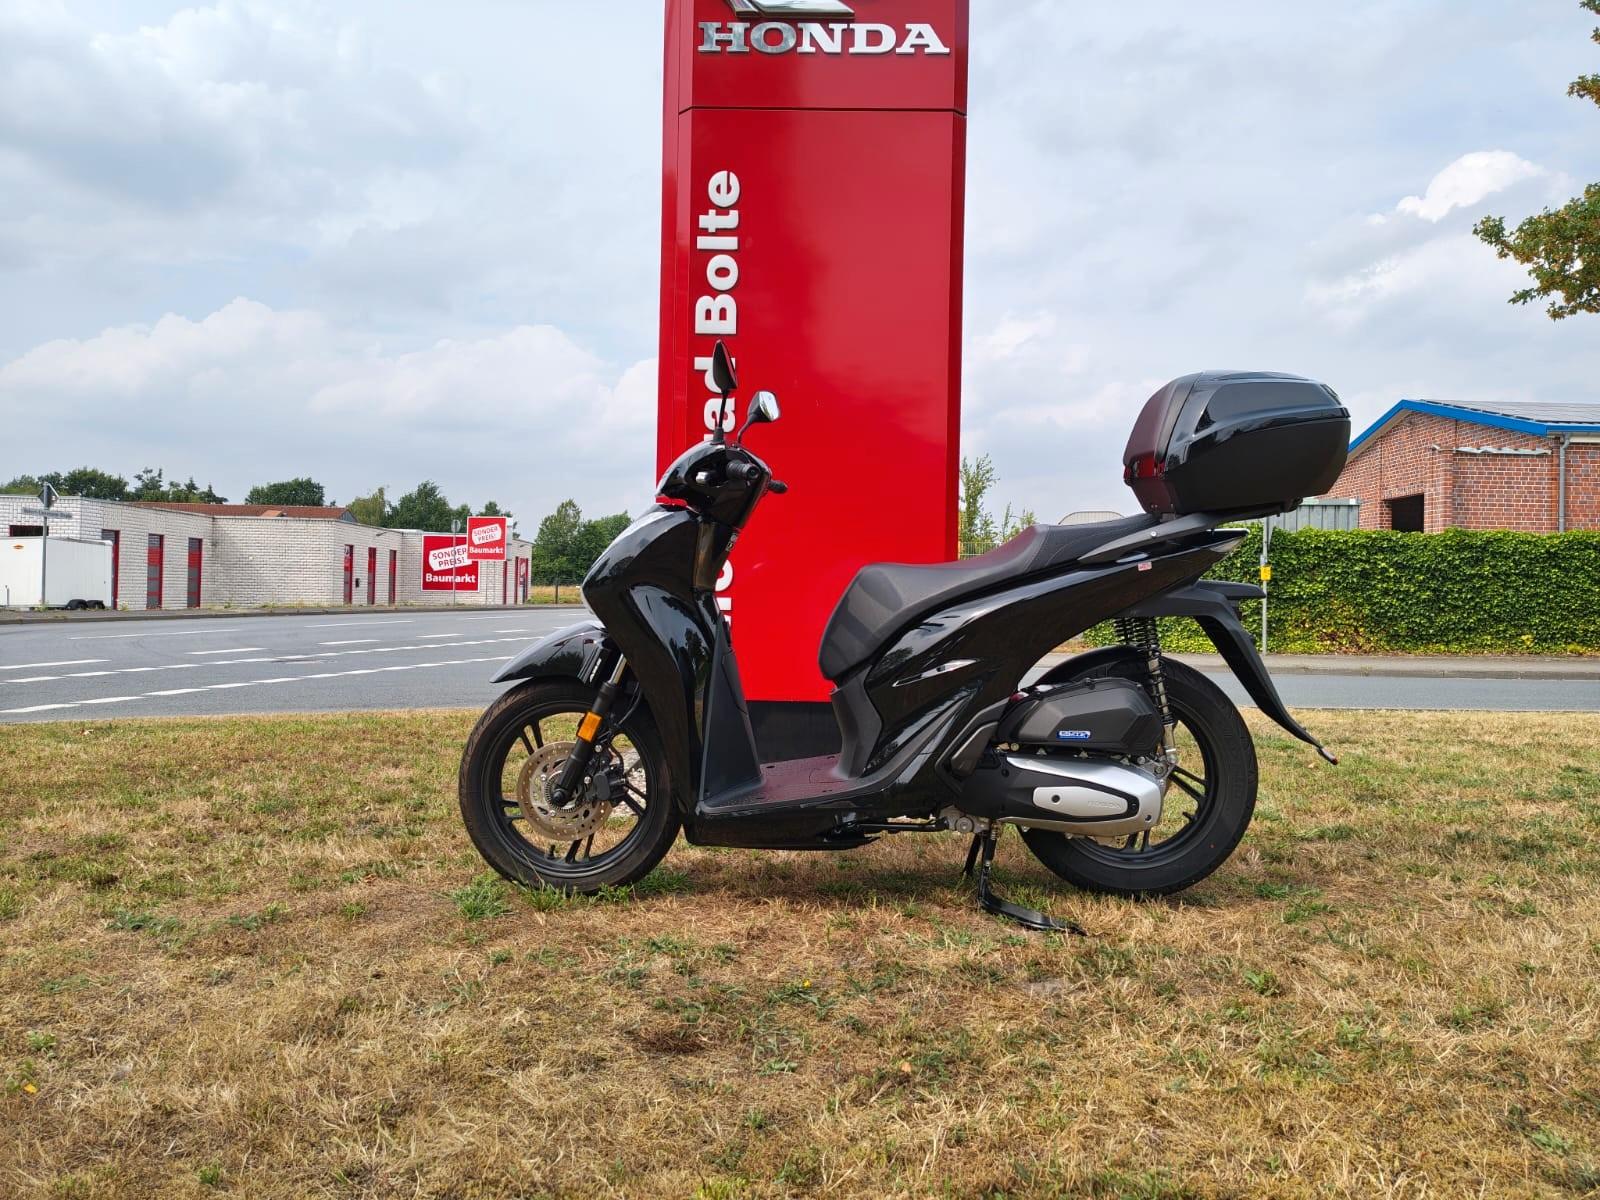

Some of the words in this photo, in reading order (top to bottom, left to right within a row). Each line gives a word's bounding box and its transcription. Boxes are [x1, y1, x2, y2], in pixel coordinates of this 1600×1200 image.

[698, 22, 950, 54] HONDA
[695, 170, 740, 334] Bolte
[469, 546, 503, 554] Baumarkt
[425, 573, 476, 583] Baumarkt
